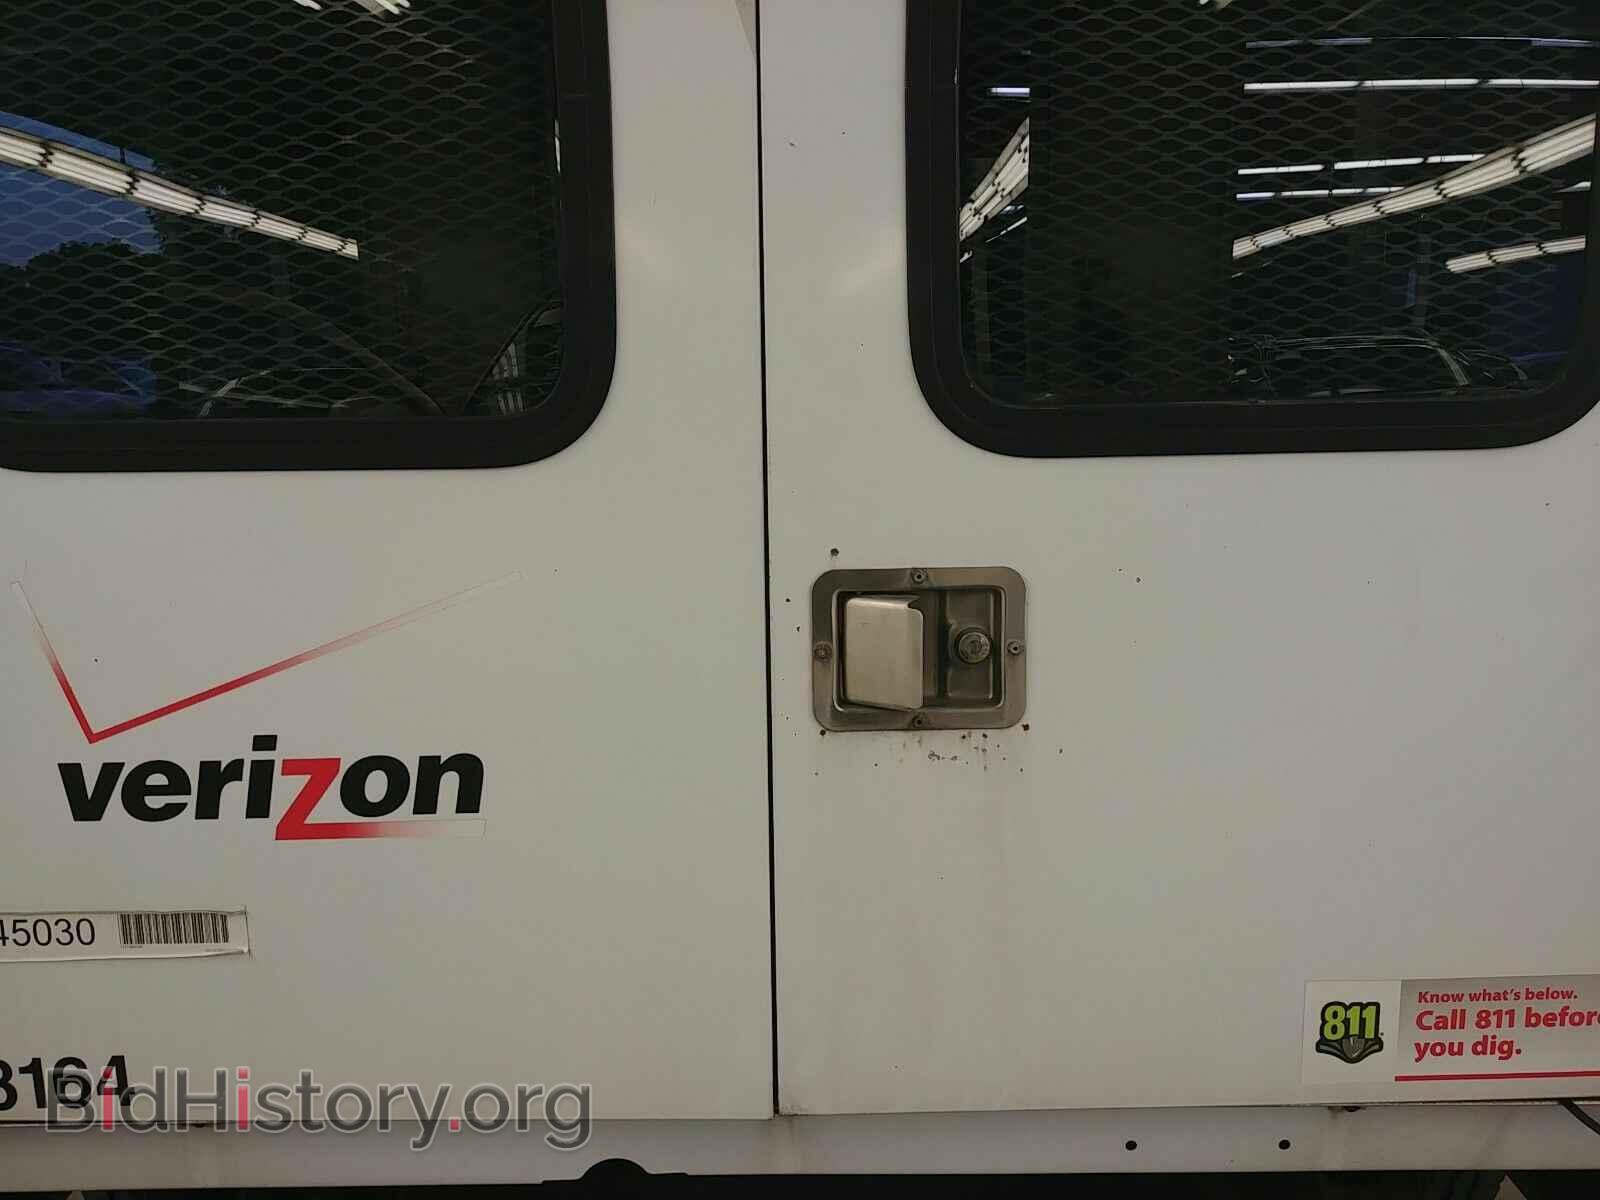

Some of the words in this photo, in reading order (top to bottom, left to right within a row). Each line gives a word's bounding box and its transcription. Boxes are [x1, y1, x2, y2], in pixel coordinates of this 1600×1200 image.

[57, 734, 486, 841] verizon
[1418, 991, 1465, 1003] Know
[1468, 988, 1520, 1002] what’s
[1524, 988, 1578, 1001] below.
[1322, 1002, 1379, 1040] 811
[1415, 1009, 1466, 1031] Call
[1474, 1008, 1515, 1029] 811
[1524, 1006, 1600, 1029] befor
[1414, 1039, 1465, 1062] you
[1471, 1035, 1522, 1060] dig.
